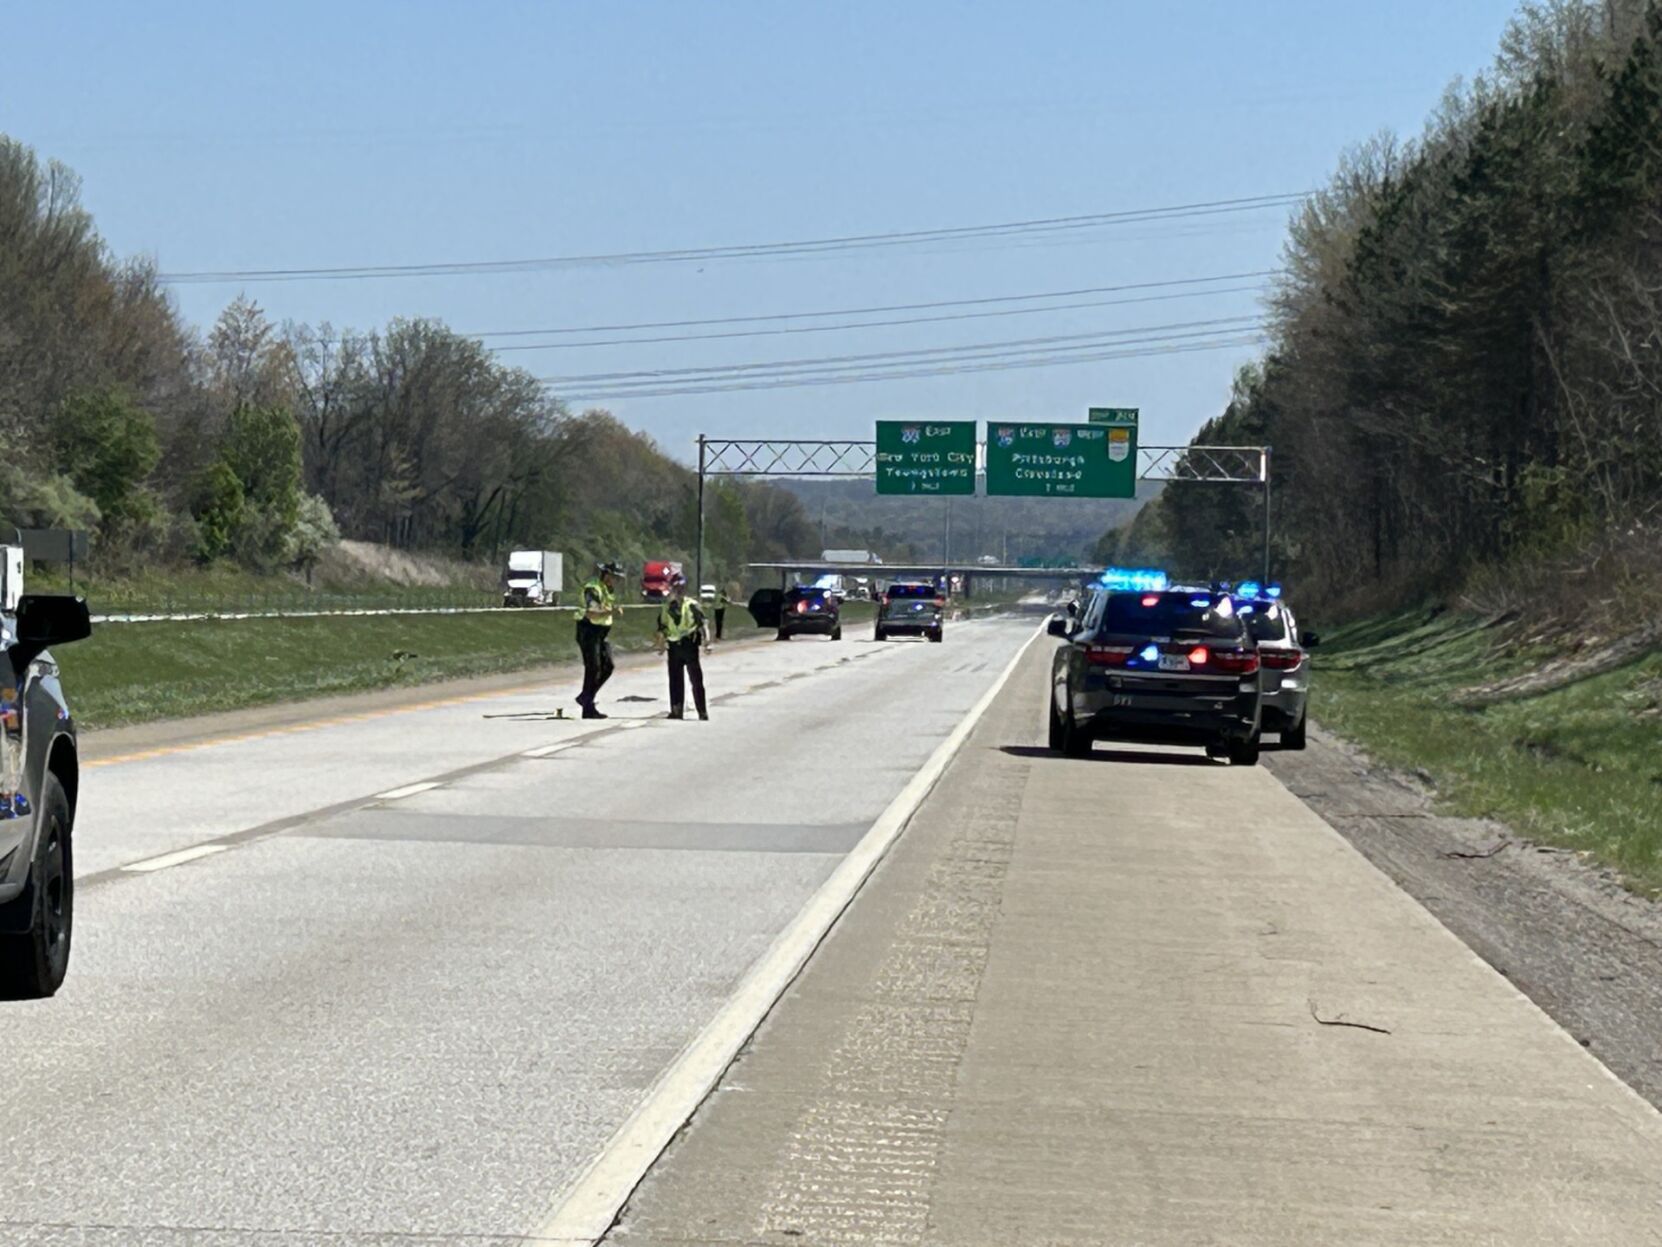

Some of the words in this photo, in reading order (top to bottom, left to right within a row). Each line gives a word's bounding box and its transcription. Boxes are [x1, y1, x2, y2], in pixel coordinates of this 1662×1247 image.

[1012, 453, 1085, 467] Pittsburgh
[886, 467, 968, 479] Youngstown
[1015, 468, 1082, 480] Cleveland
